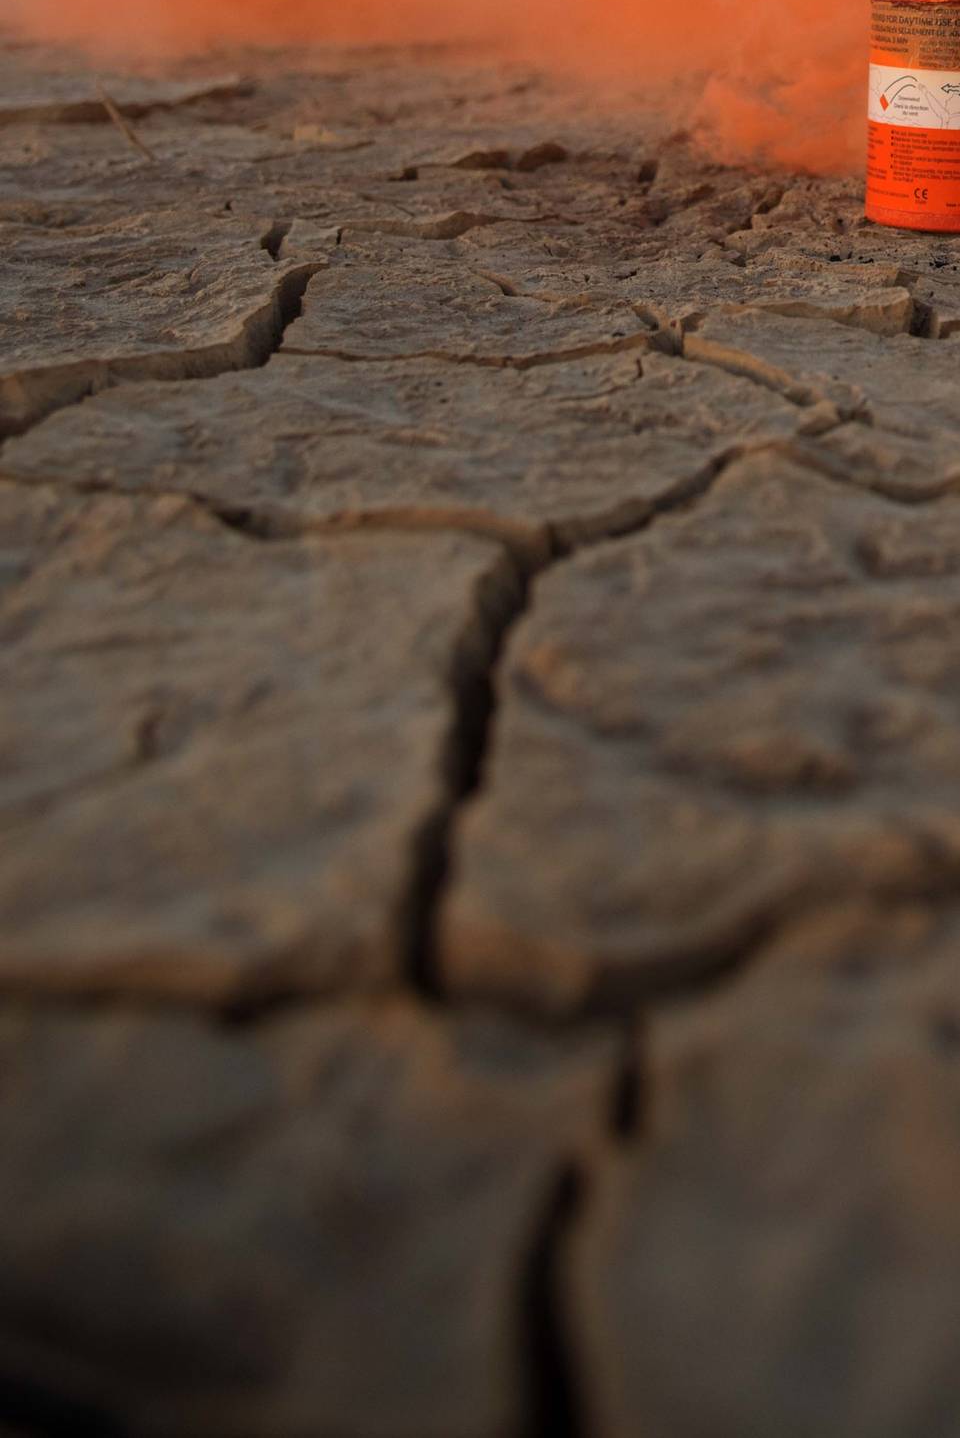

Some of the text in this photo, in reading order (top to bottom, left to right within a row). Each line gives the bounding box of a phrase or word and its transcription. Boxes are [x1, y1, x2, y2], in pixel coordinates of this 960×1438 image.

[899, 16, 936, 26] DAYTIME
[936, 18, 953, 27] USE
[913, 187, 928, 200] CE
